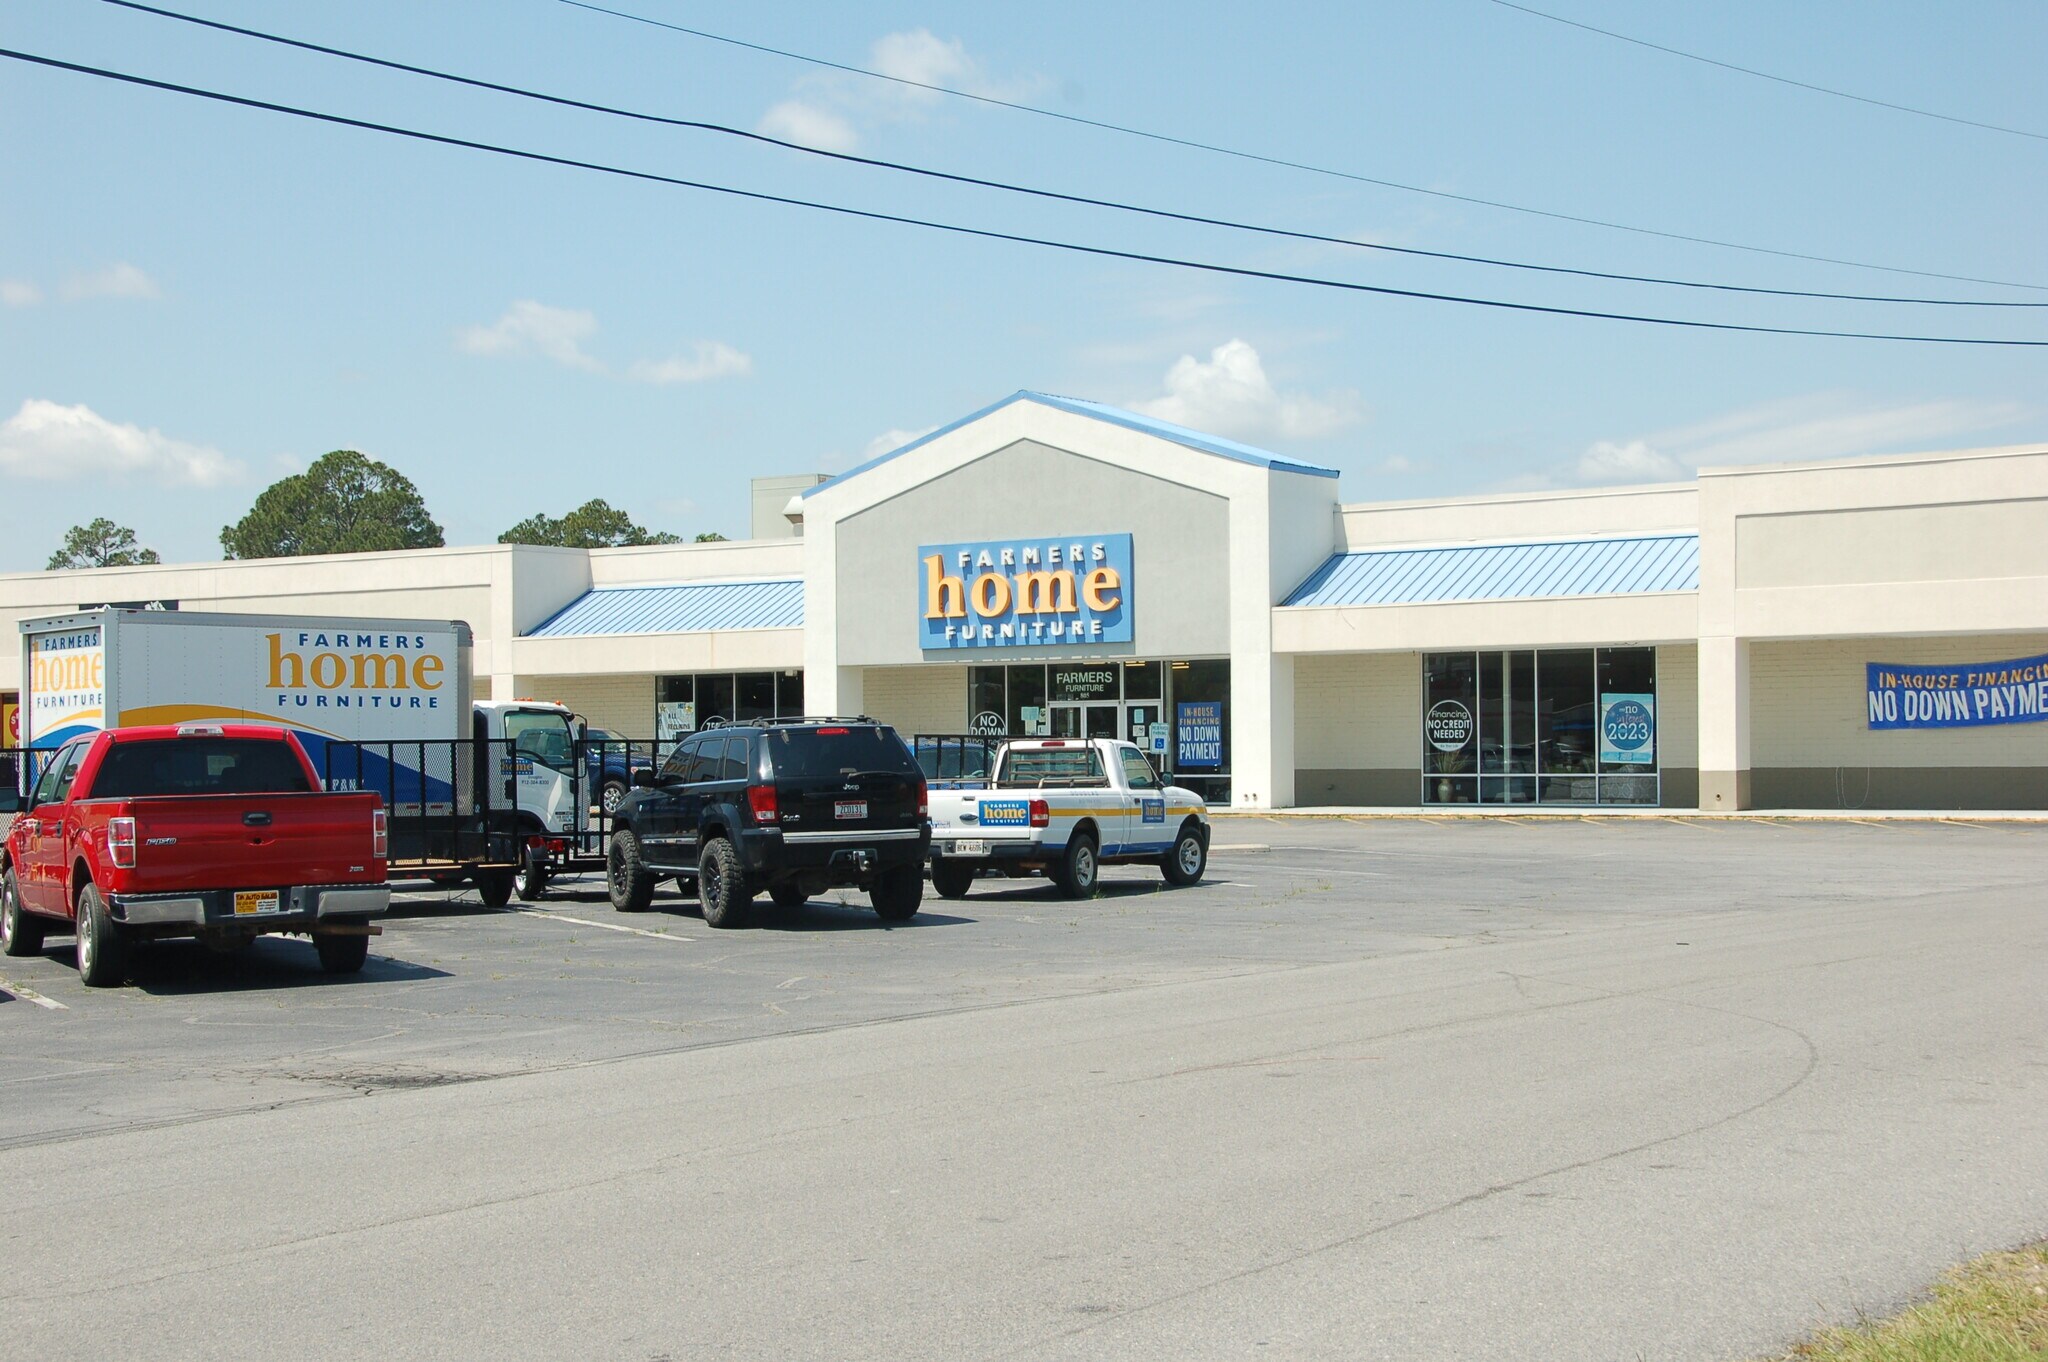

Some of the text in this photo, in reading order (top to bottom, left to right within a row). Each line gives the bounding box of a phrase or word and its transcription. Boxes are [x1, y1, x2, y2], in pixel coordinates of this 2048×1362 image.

[958, 542, 1106, 568] FARMERS
[923, 554, 1121, 618] home
[945, 619, 1103, 640] FURNITURE
[45, 633, 97, 650] FARMERS
[299, 633, 425, 649] FARMERS
[32, 640, 103, 692] home
[265, 633, 444, 690] home
[1056, 671, 1113, 684] FARMERS
[1879, 672, 1959, 689] IN-HOUSE
[1065, 684, 1105, 692] FURNITURE
[37, 693, 103, 708] FURNITURE
[278, 694, 438, 708] FURNITURE
[1868, 682, 2048, 722] NO DOWN PAYME
[1184, 706, 1214, 716] IN-HOUSE
[1431, 710, 1468, 719] Financing
[1625, 705, 1638, 713] no
[980, 715, 997, 726] NO
[1180, 717, 1220, 725] FINANCING
[1428, 719, 1470, 729] NO CREDIT
[970, 727, 1005, 736] DOWN
[1179, 725, 1220, 741] NO DOWN
[1433, 729, 1465, 739] NEEDED
[1608, 723, 1649, 740] 2023
[1179, 743, 1220, 760] PAYMENT
[842, 783, 860, 791] Jeep
[984, 804, 1027, 819] home
